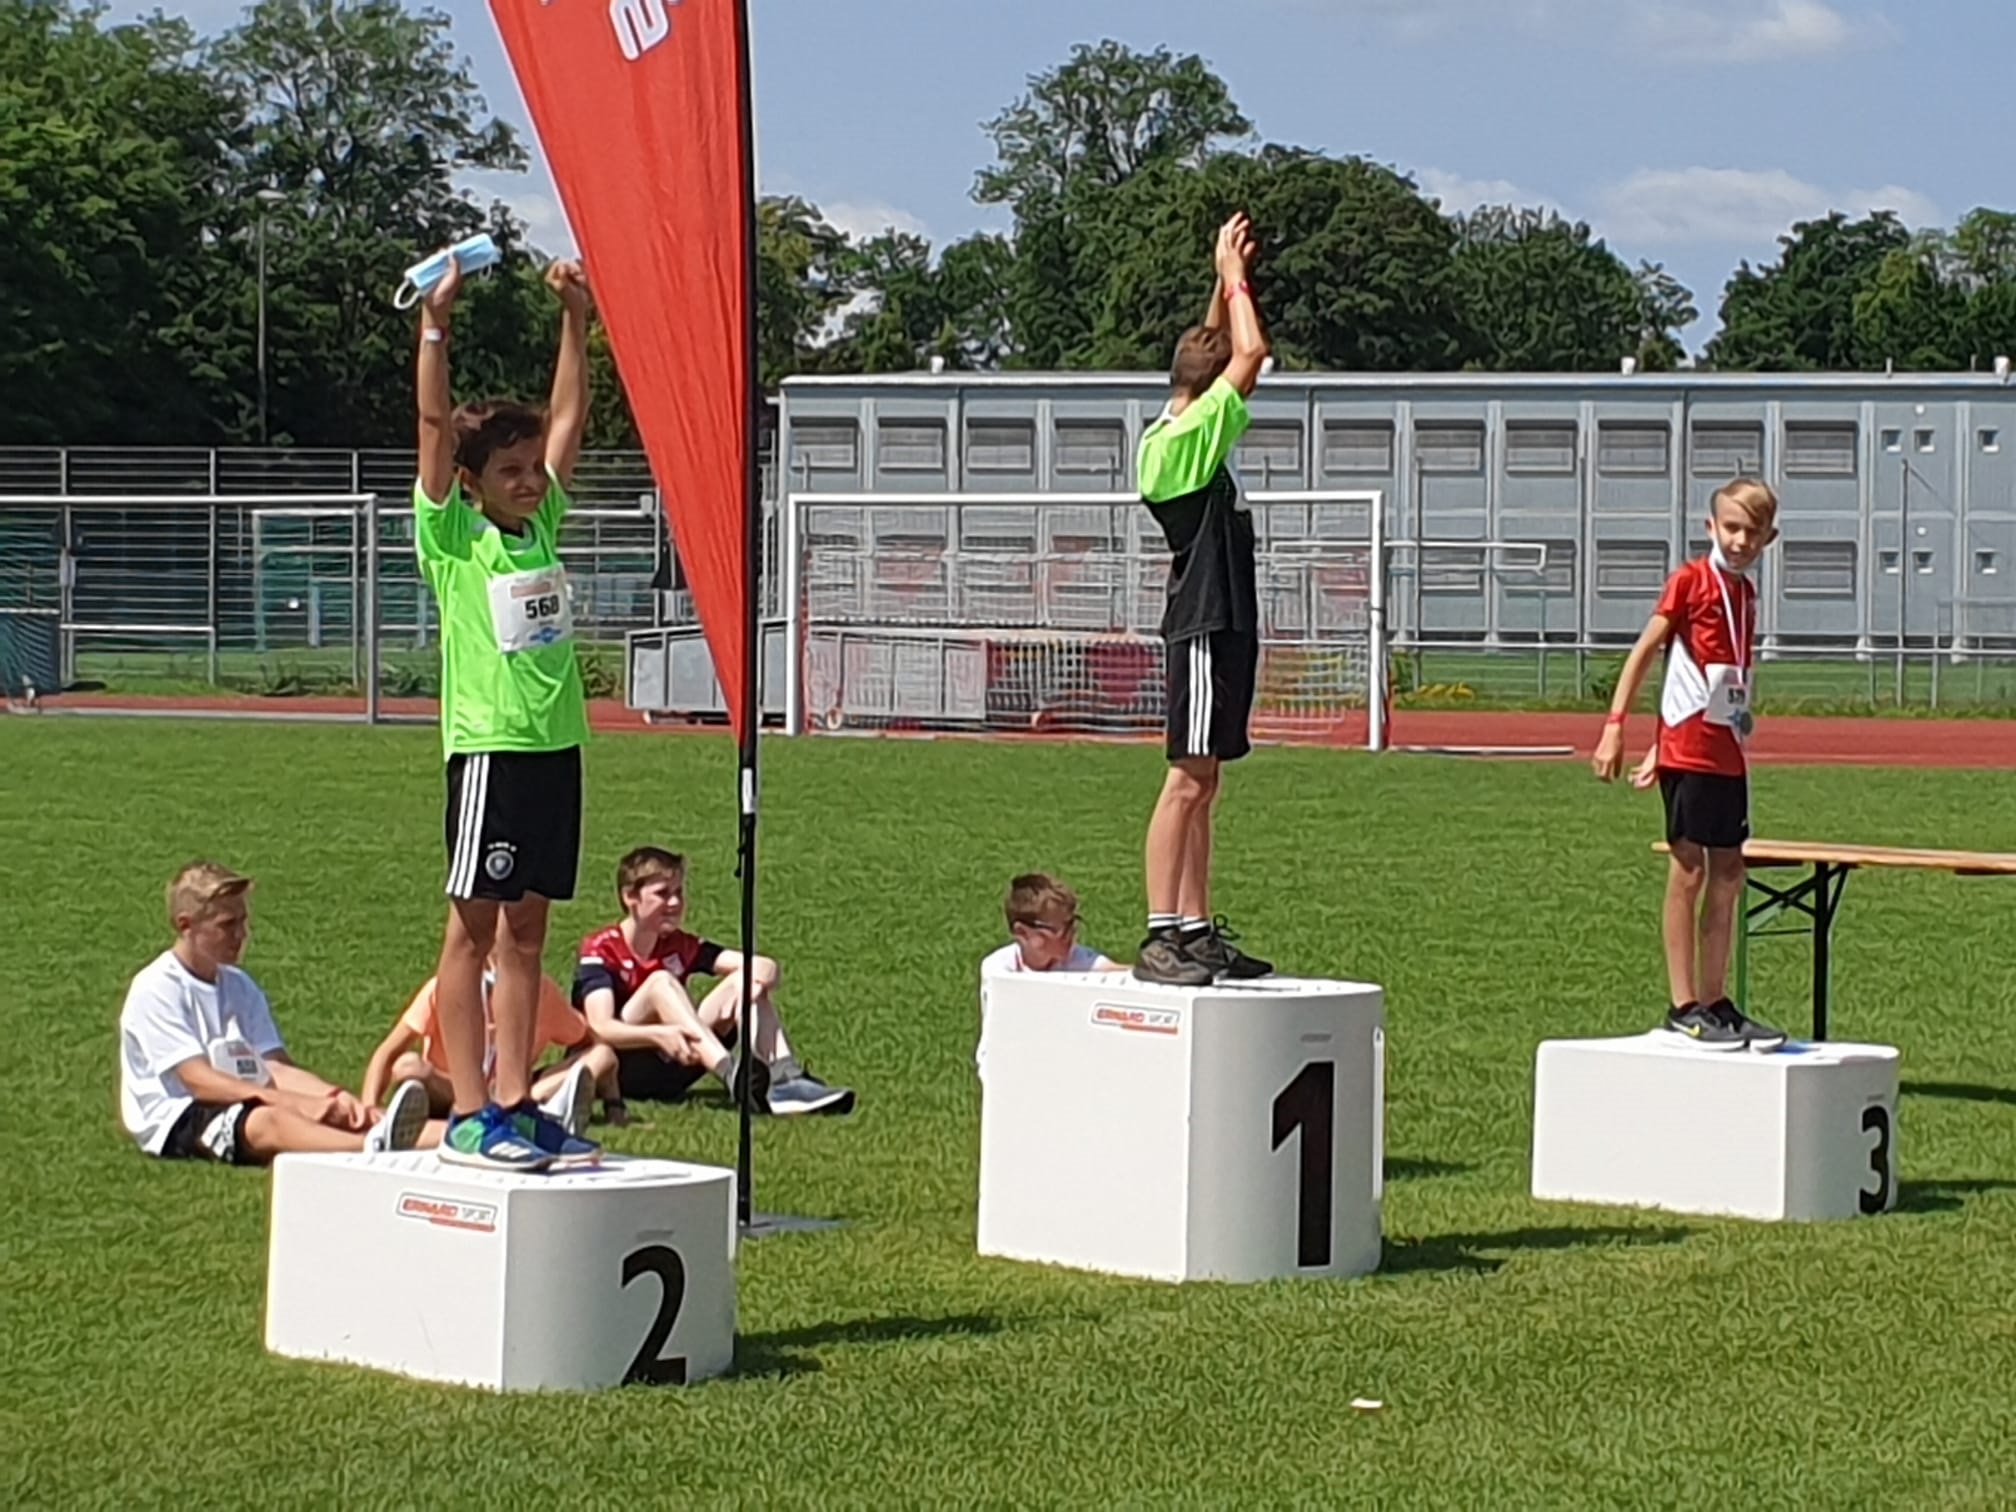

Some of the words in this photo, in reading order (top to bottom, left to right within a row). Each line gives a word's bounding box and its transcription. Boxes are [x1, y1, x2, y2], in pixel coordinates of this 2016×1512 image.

[1271, 1061, 1335, 1267] 1
[1860, 1105, 1889, 1215] 3
[621, 1245, 687, 1387] 2
